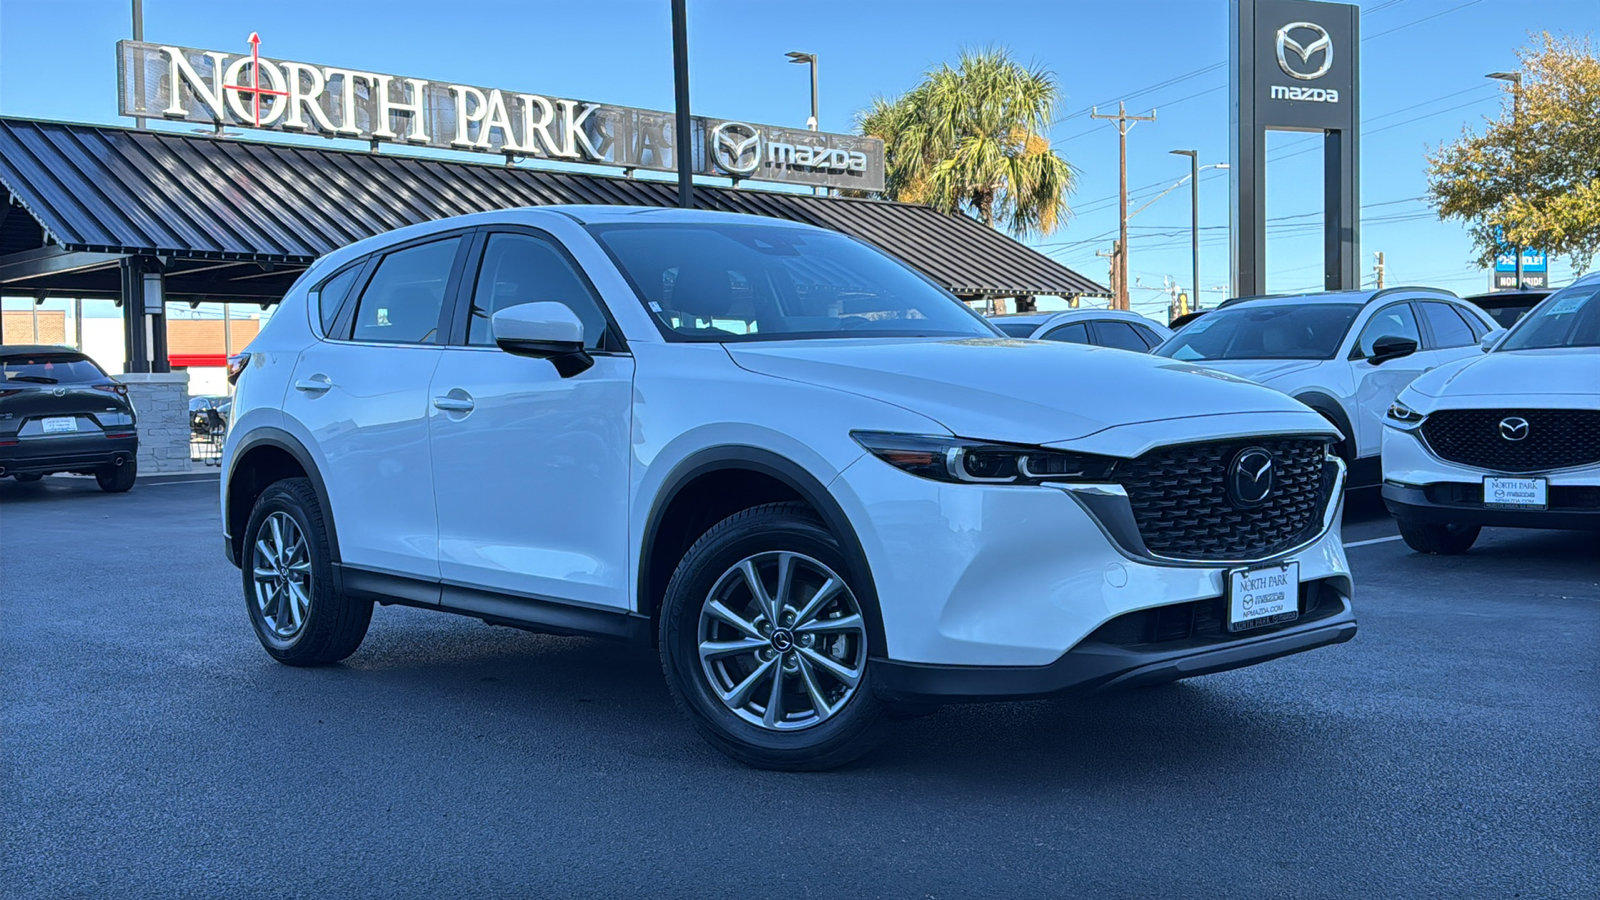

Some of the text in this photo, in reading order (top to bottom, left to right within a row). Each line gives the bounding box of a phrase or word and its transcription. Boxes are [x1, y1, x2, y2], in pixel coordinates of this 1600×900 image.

[159, 46, 606, 160] NORTH PARK
[1271, 85, 1339, 103] mazda
[767, 141, 867, 172] mazda
[1491, 481, 1538, 490] NORTH PARK
[1240, 573, 1288, 592] NORTH PARK
[1243, 605, 1284, 618] NPMAZDA.COM
